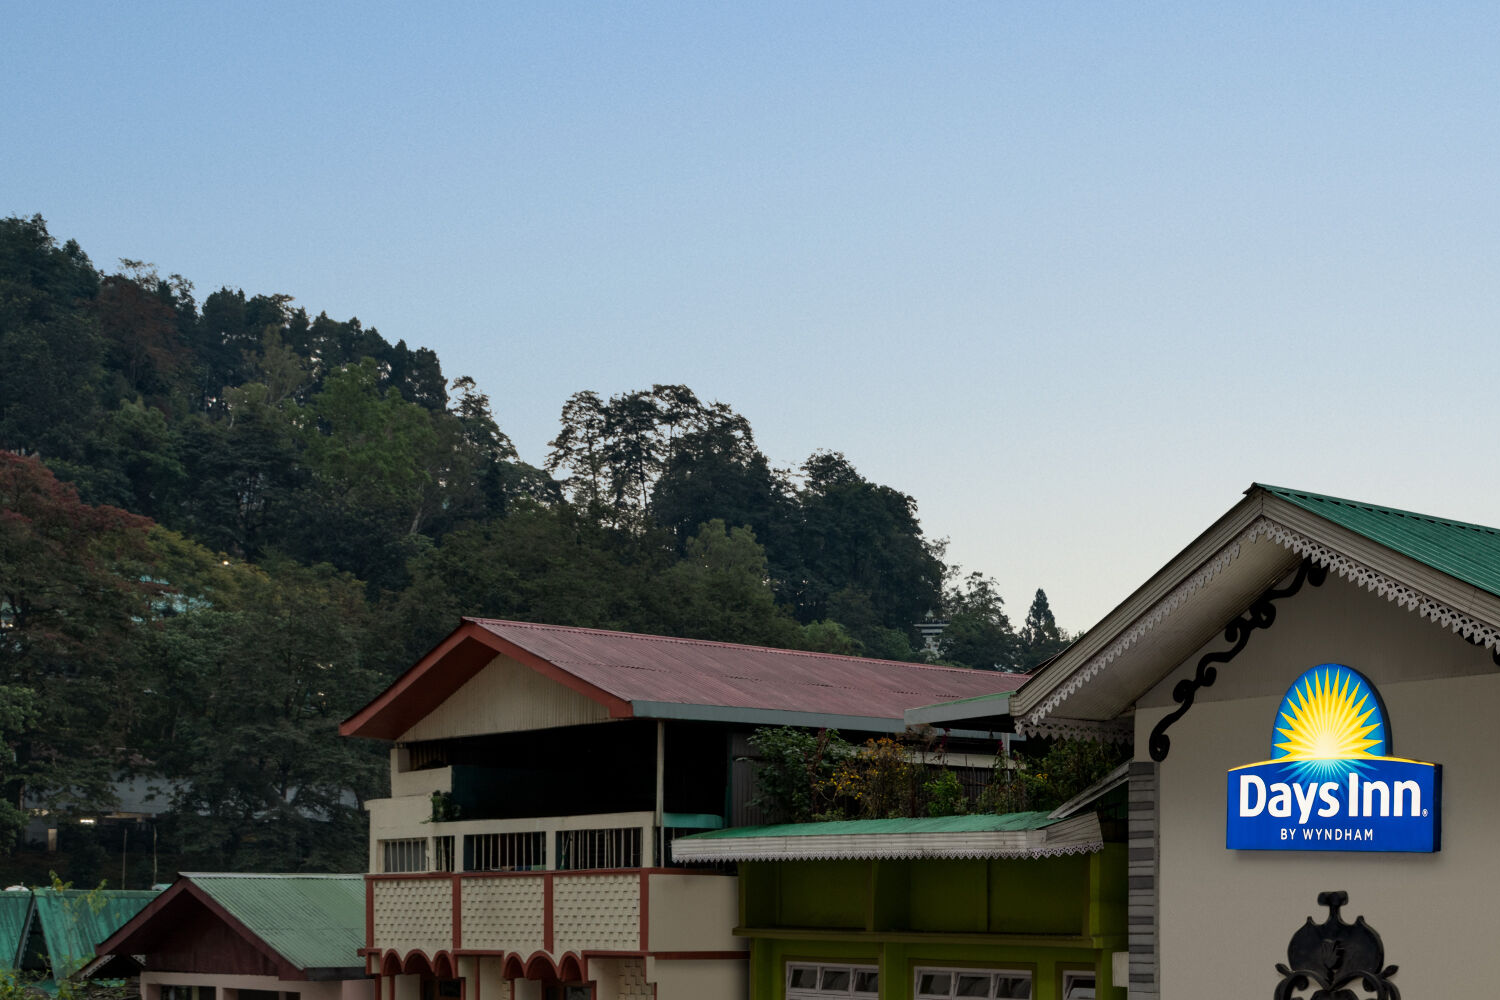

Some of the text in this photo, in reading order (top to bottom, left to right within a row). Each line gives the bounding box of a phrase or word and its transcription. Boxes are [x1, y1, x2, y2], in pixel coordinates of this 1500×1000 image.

[1239, 772, 1421, 824] Days Inn
[1280, 828, 1373, 841] BY WYNDHAM
